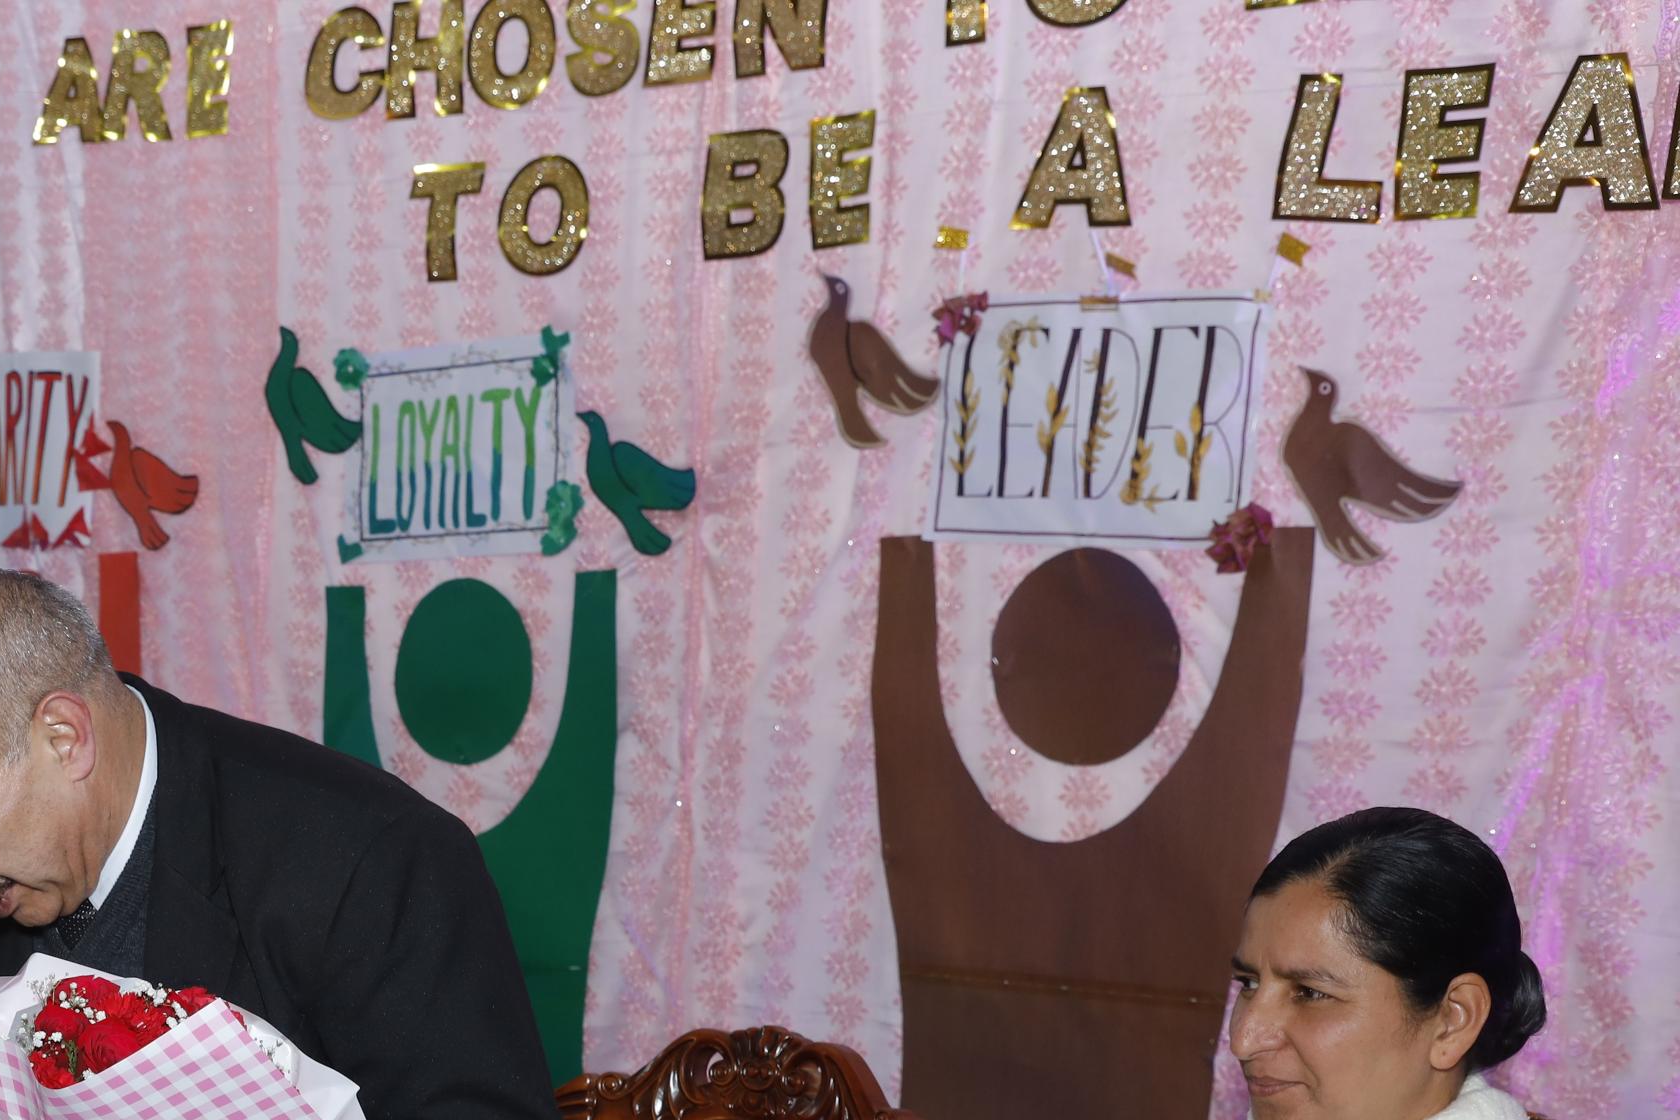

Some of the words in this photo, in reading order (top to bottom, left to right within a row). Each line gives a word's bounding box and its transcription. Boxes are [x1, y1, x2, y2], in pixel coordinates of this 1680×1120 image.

[33, 20, 233, 146] ARE
[304, 0, 828, 120] CHOSEN
[409, 154, 590, 282] TO
[701, 108, 877, 261] BE
[1009, 85, 1131, 229] A
[1271, 51, 1680, 226] LEA
[367, 386, 543, 535] LOYALTY
[952, 322, 1246, 506] LEADER
